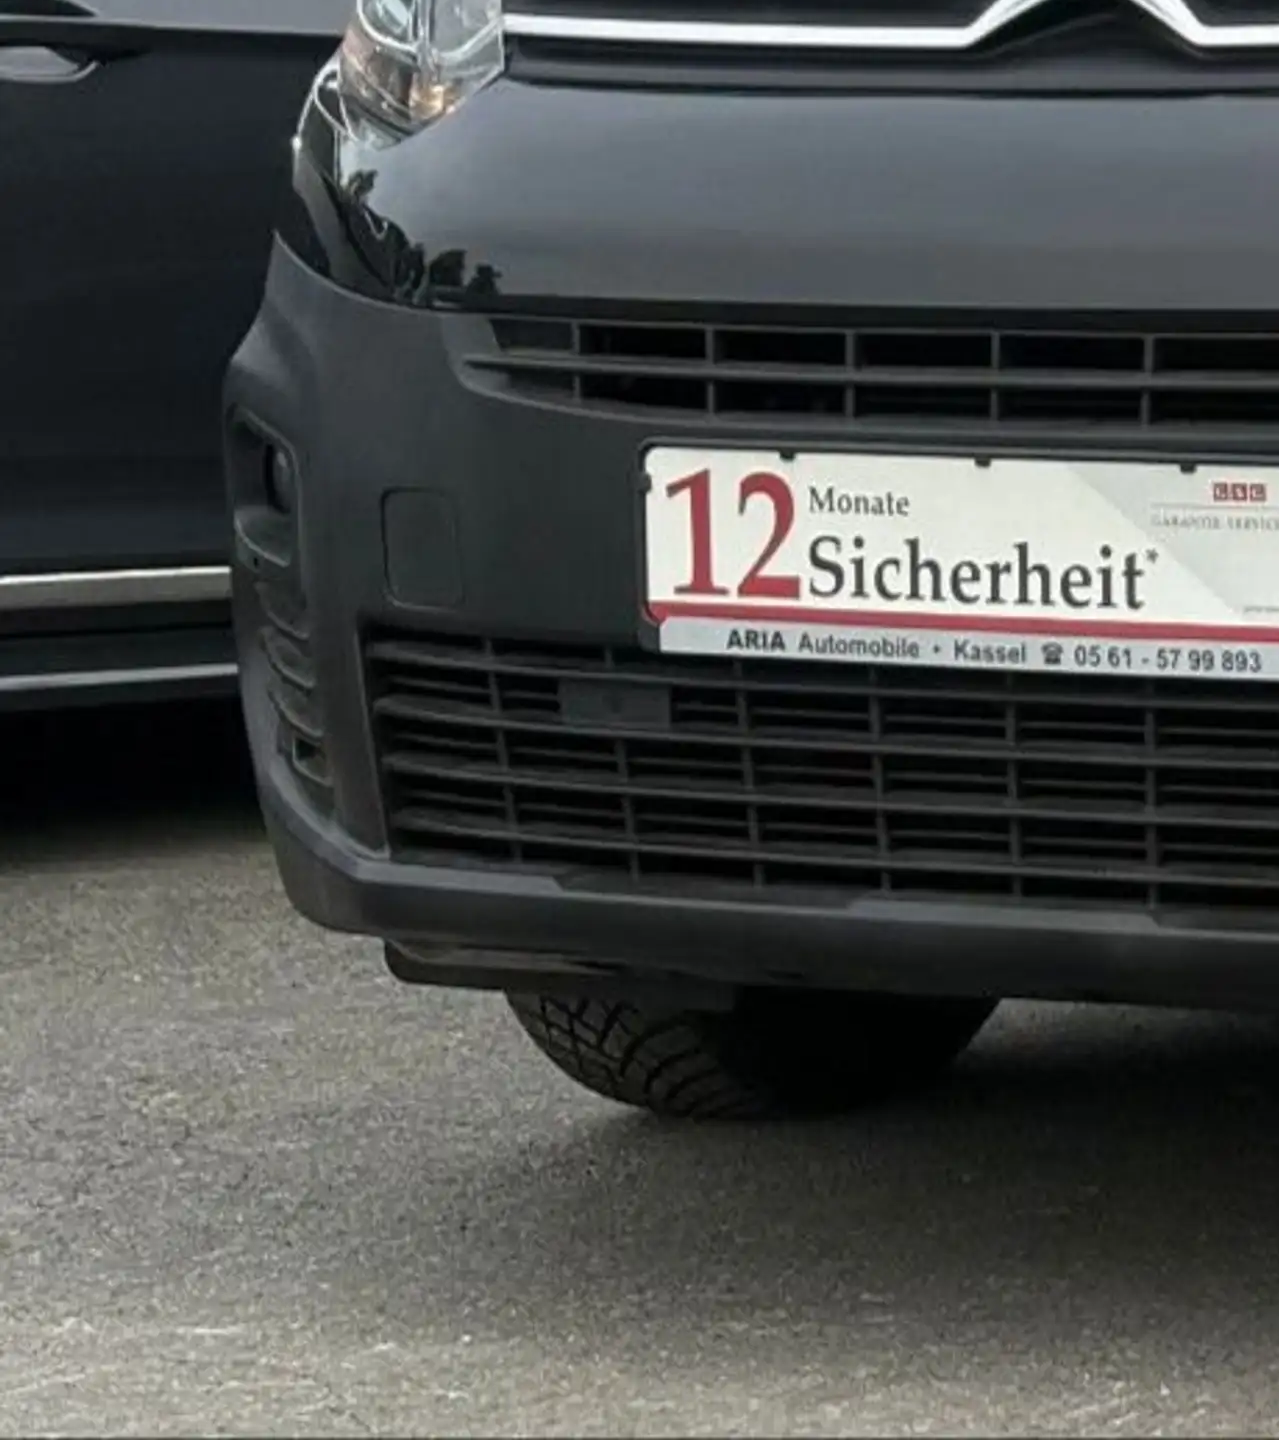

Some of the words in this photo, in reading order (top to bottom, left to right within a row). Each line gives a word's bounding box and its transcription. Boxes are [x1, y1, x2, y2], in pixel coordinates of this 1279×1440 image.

[808, 485, 910, 517] Monate
[665, 467, 800, 600] 12
[726, 629, 786, 651] ARIA
[798, 632, 920, 659] Automobile
[954, 640, 1027, 664] Kassel
[1074, 645, 1101, 667] 05
[1107, 647, 1132, 669] 61
[1156, 649, 1182, 671] 57
[1188, 651, 1215, 672] 99
[1221, 652, 1262, 673] 893
